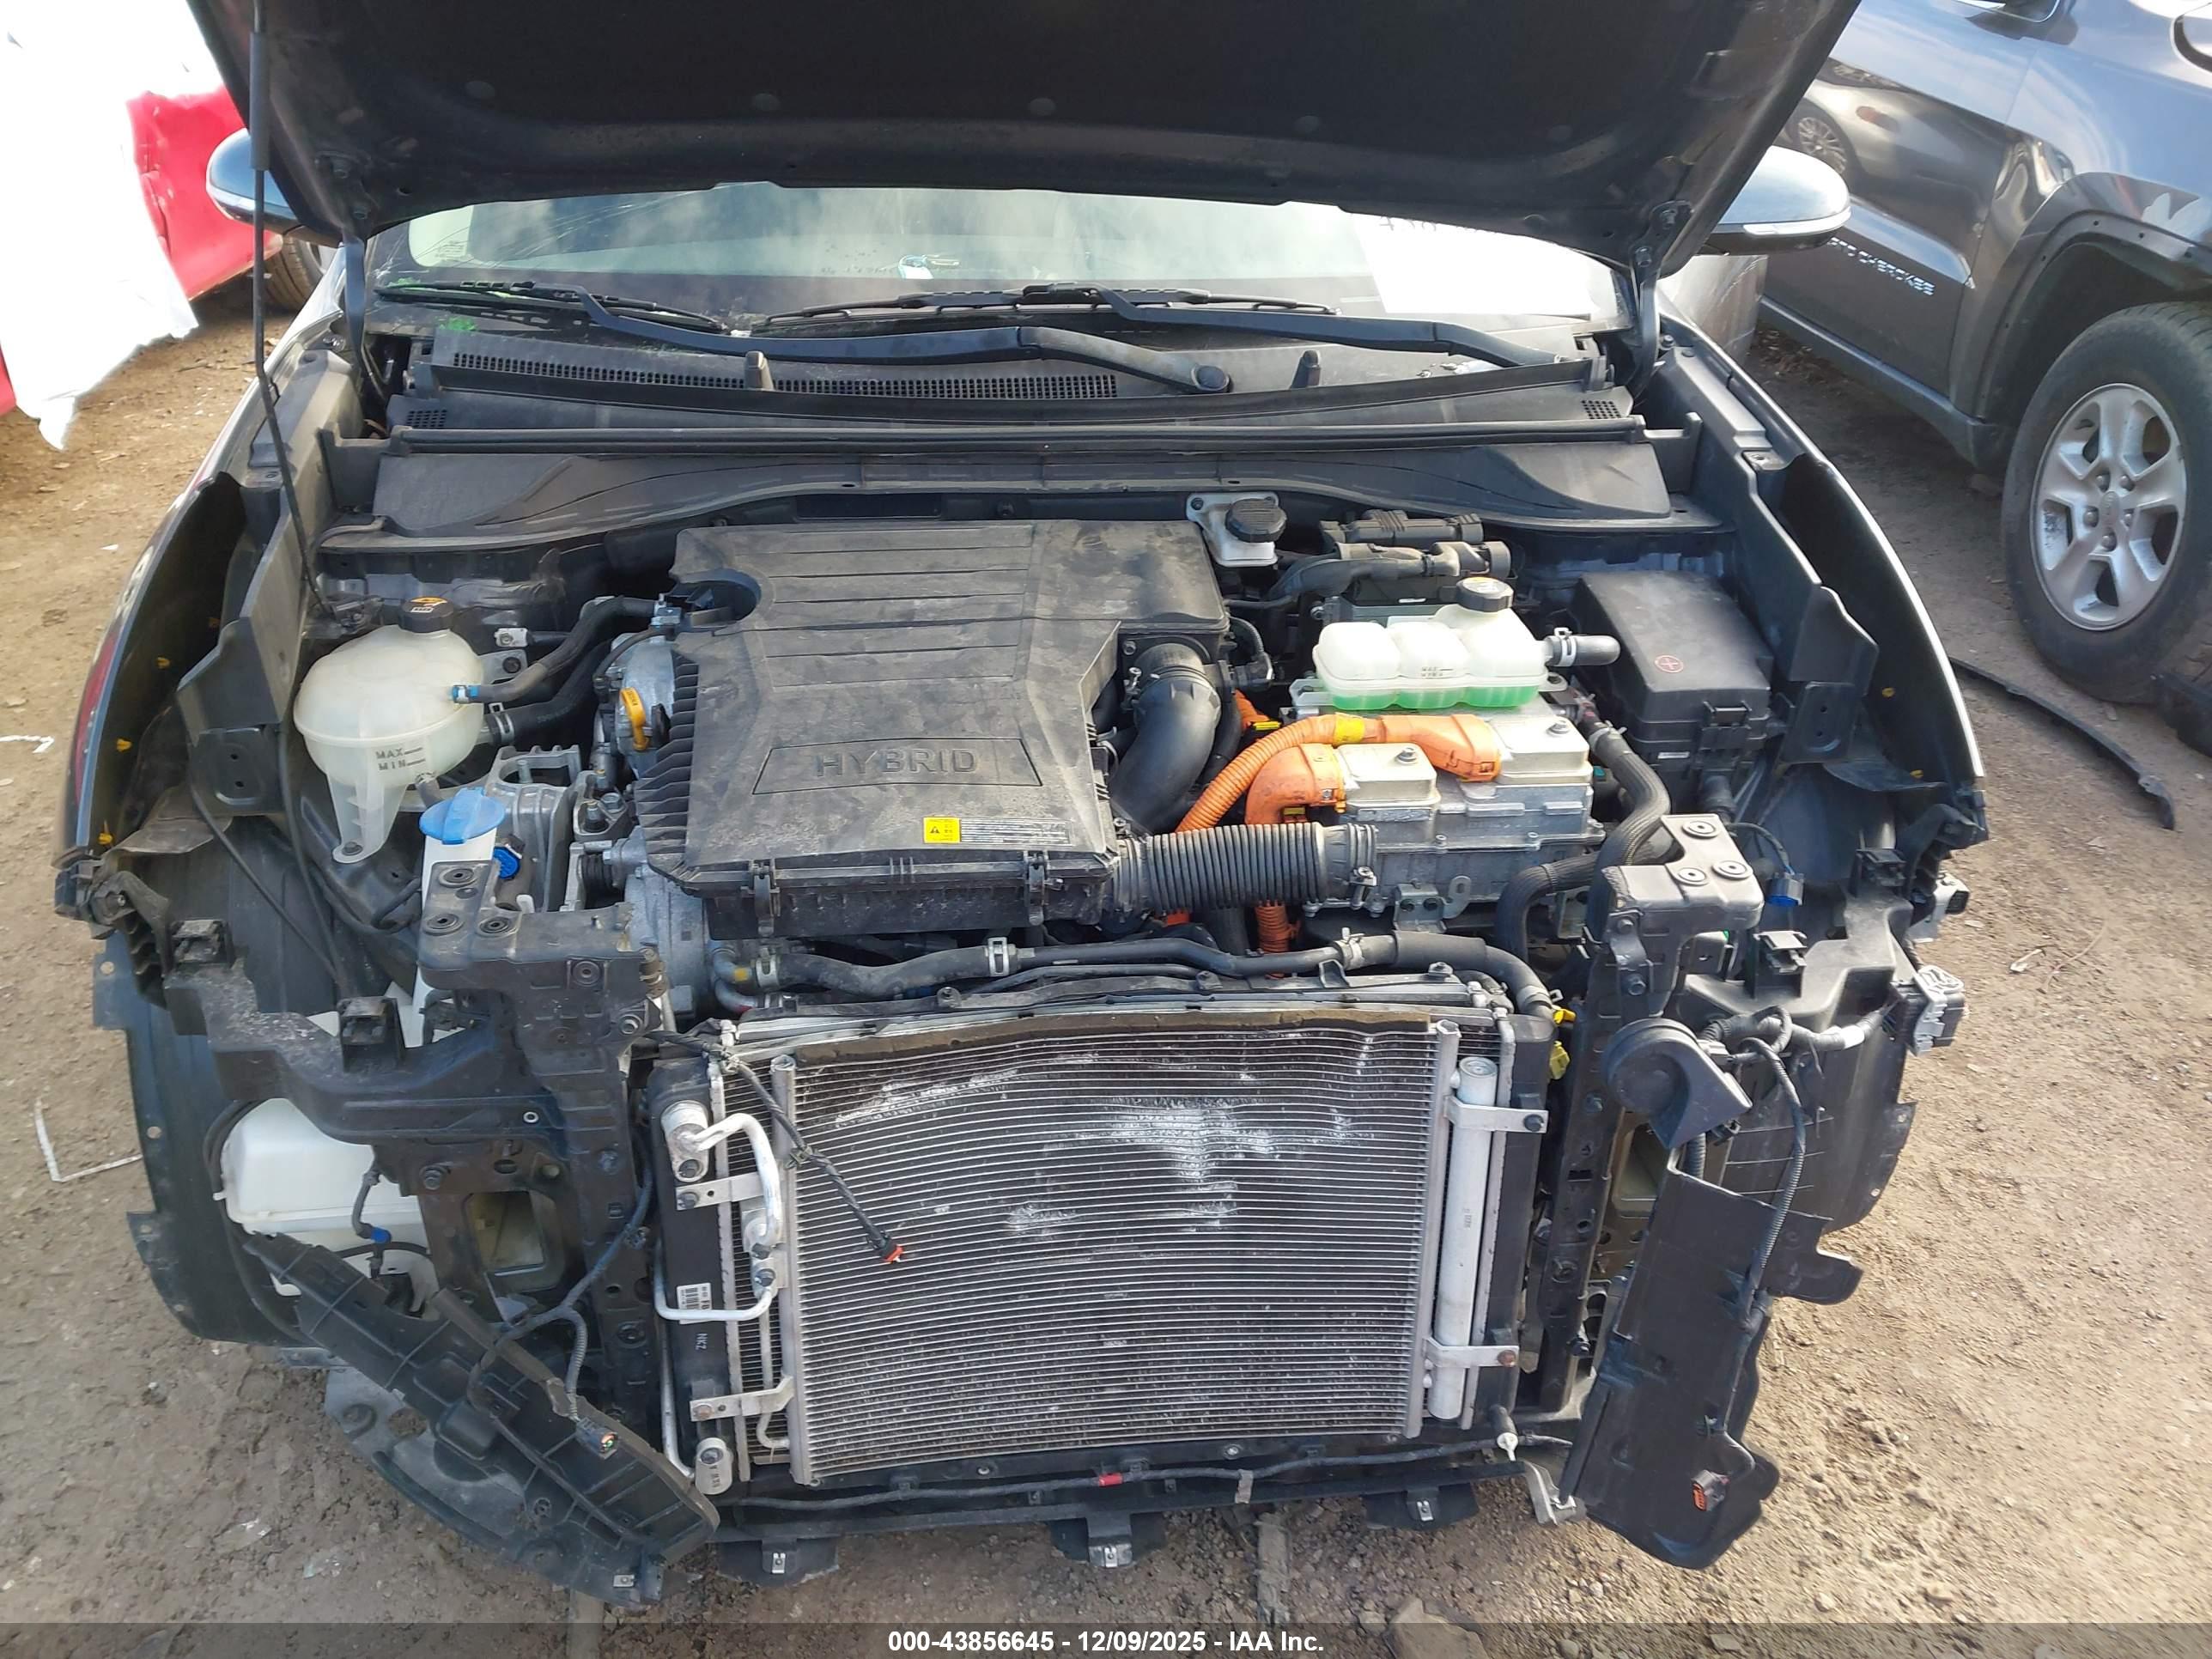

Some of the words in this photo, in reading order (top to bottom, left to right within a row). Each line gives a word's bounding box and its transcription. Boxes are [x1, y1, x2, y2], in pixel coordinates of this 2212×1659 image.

[375, 748, 404, 759] MAX
[378, 759, 406, 771] MIN
[815, 748, 978, 777] HYBRID
